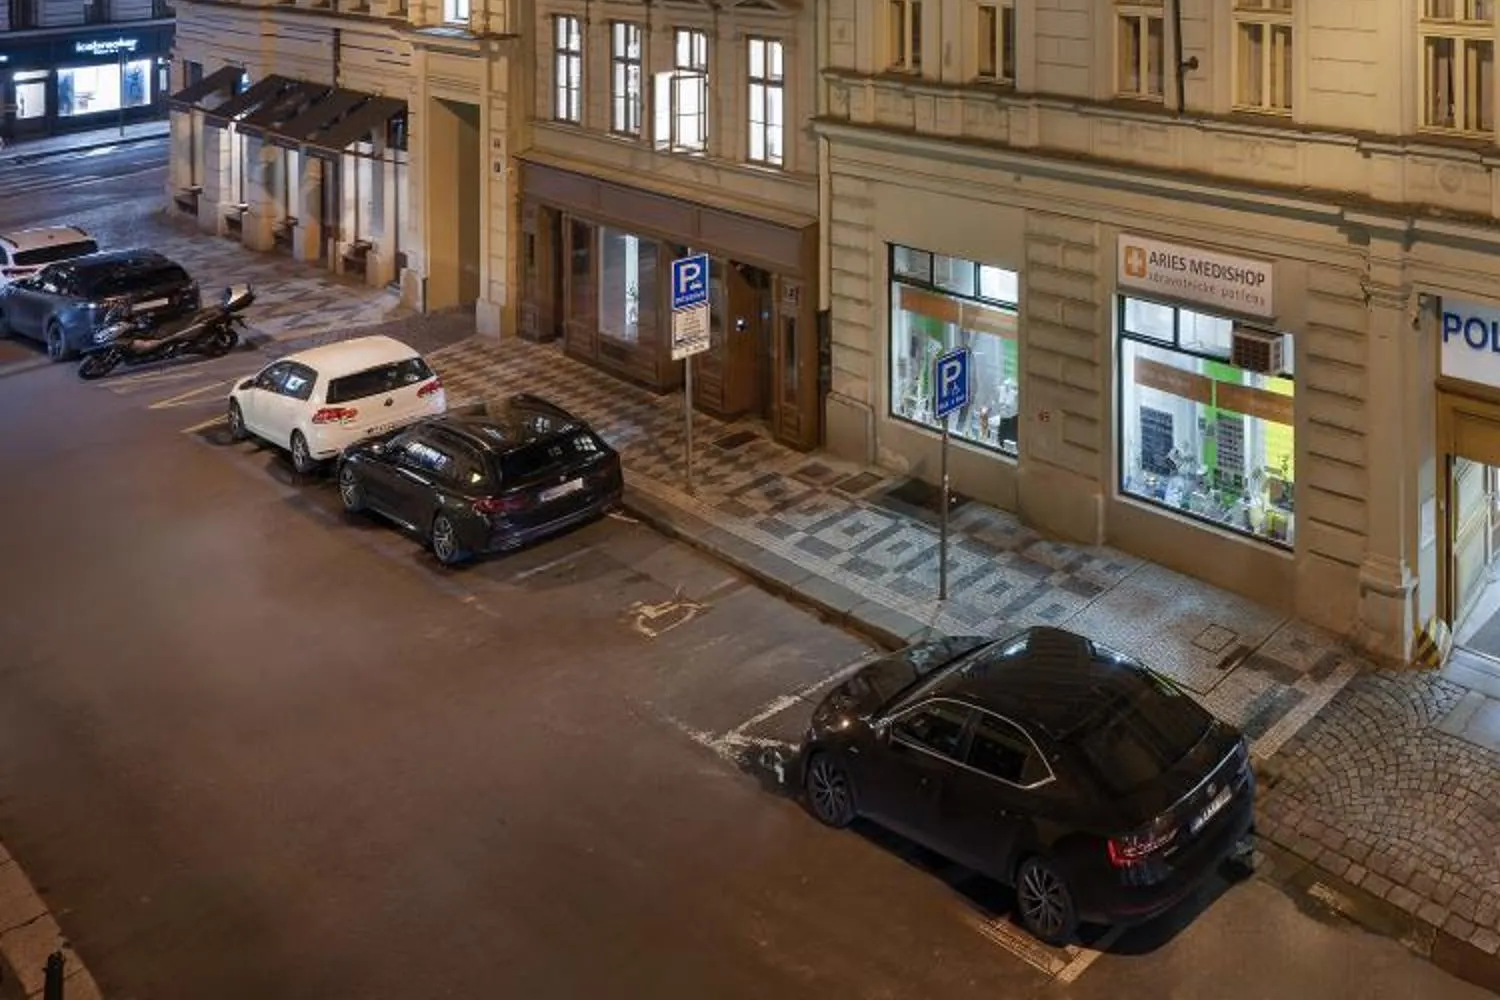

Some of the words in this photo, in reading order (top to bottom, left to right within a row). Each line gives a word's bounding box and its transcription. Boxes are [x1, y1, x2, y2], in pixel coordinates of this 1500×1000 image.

[680, 263, 701, 294] P
[1149, 251, 1187, 272] ARIES
[1189, 259, 1266, 288] MEDISHOP
[943, 361, 962, 398] P
